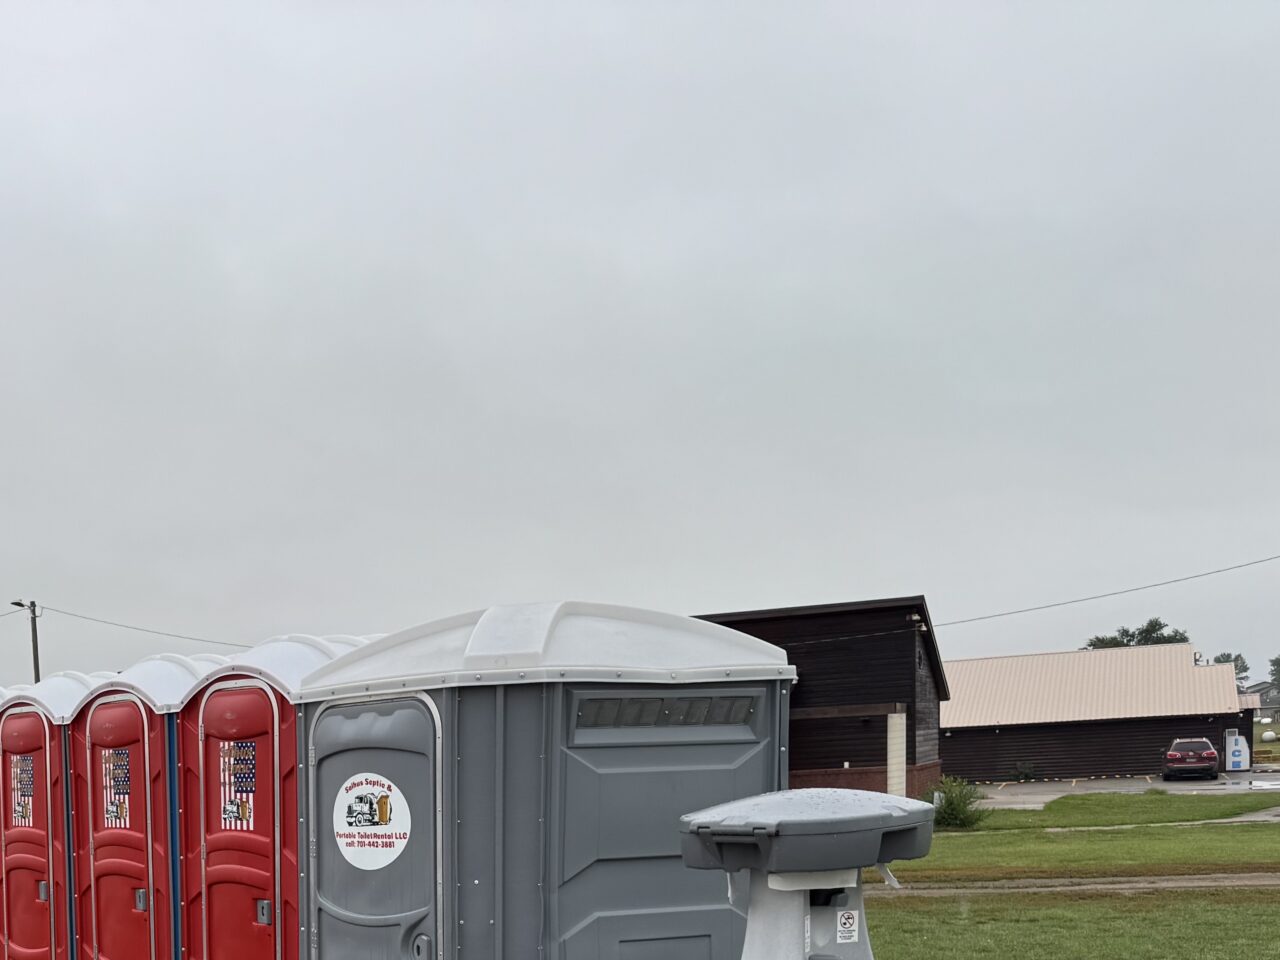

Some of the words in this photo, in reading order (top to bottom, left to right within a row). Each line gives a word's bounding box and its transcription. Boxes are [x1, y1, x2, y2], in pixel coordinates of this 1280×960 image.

[365, 778, 385, 788] Septic
[387, 784, 393, 792] &
[358, 832, 373, 840] Toilet
[395, 832, 408, 840] LLC
